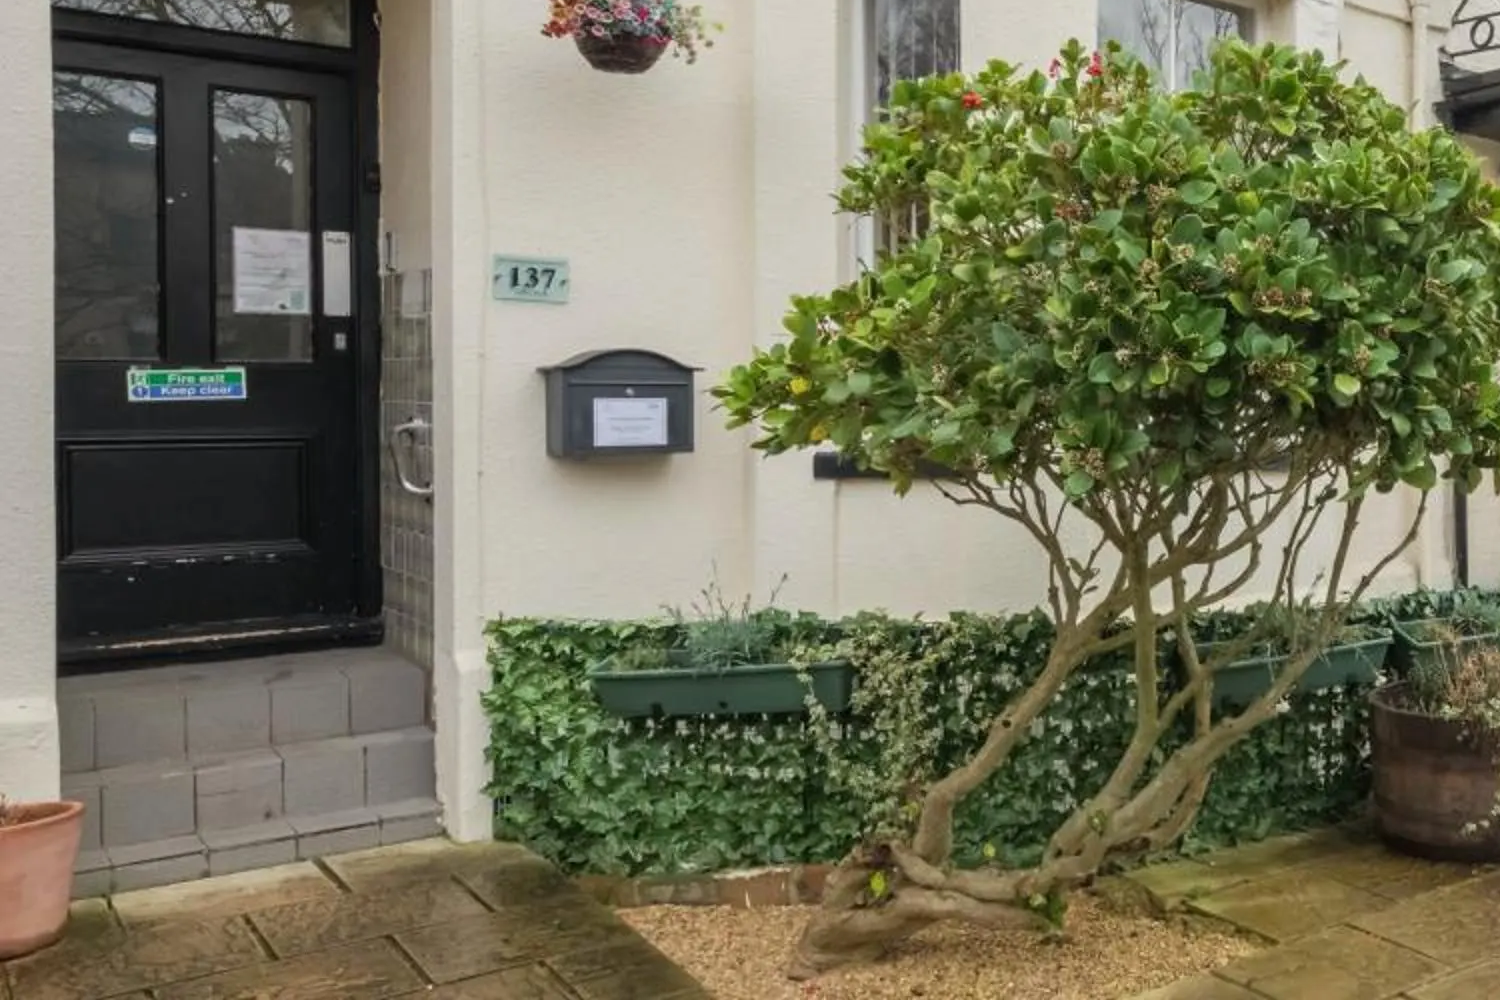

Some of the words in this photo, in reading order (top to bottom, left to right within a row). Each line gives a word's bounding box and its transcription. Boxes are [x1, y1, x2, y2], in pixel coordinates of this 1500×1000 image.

[510, 266, 556, 290] 137
[167, 374, 195, 385] Fire
[199, 374, 225, 384] exit
[161, 386, 197, 397] Keep
[199, 385, 232, 395] clear
